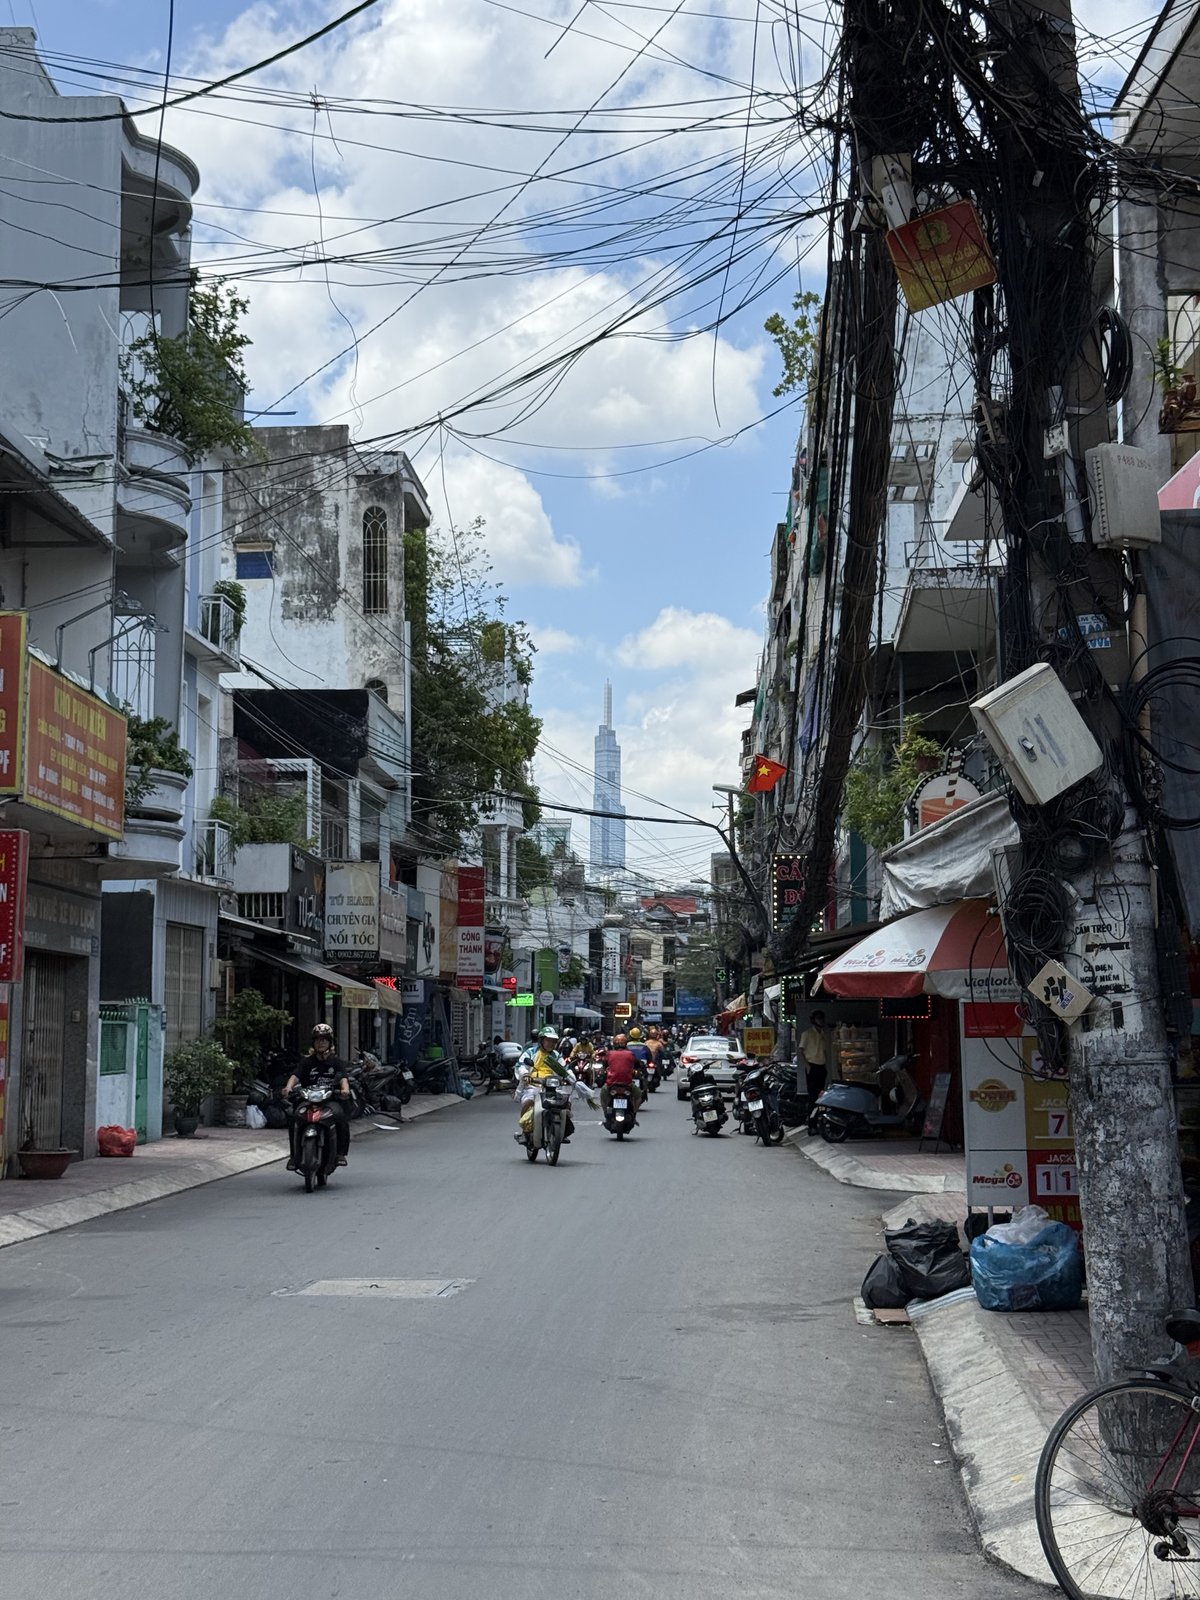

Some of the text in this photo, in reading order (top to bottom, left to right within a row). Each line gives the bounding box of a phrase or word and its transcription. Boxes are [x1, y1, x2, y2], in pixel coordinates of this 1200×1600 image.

[964, 256, 991, 279] NINH
[777, 858, 806, 880] CẦ
[346, 896, 375, 906] HAIR
[361, 914, 376, 926] GIA
[329, 929, 375, 945] NỐI TÓC
[461, 930, 480, 941] CÔNG
[403, 984, 419, 992] AIL
[964, 977, 1013, 988] Vietlott
[1051, 1114, 1065, 1134] 7
[1046, 1154, 1076, 1163] JACK
[972, 1175, 1005, 1185] Mega
